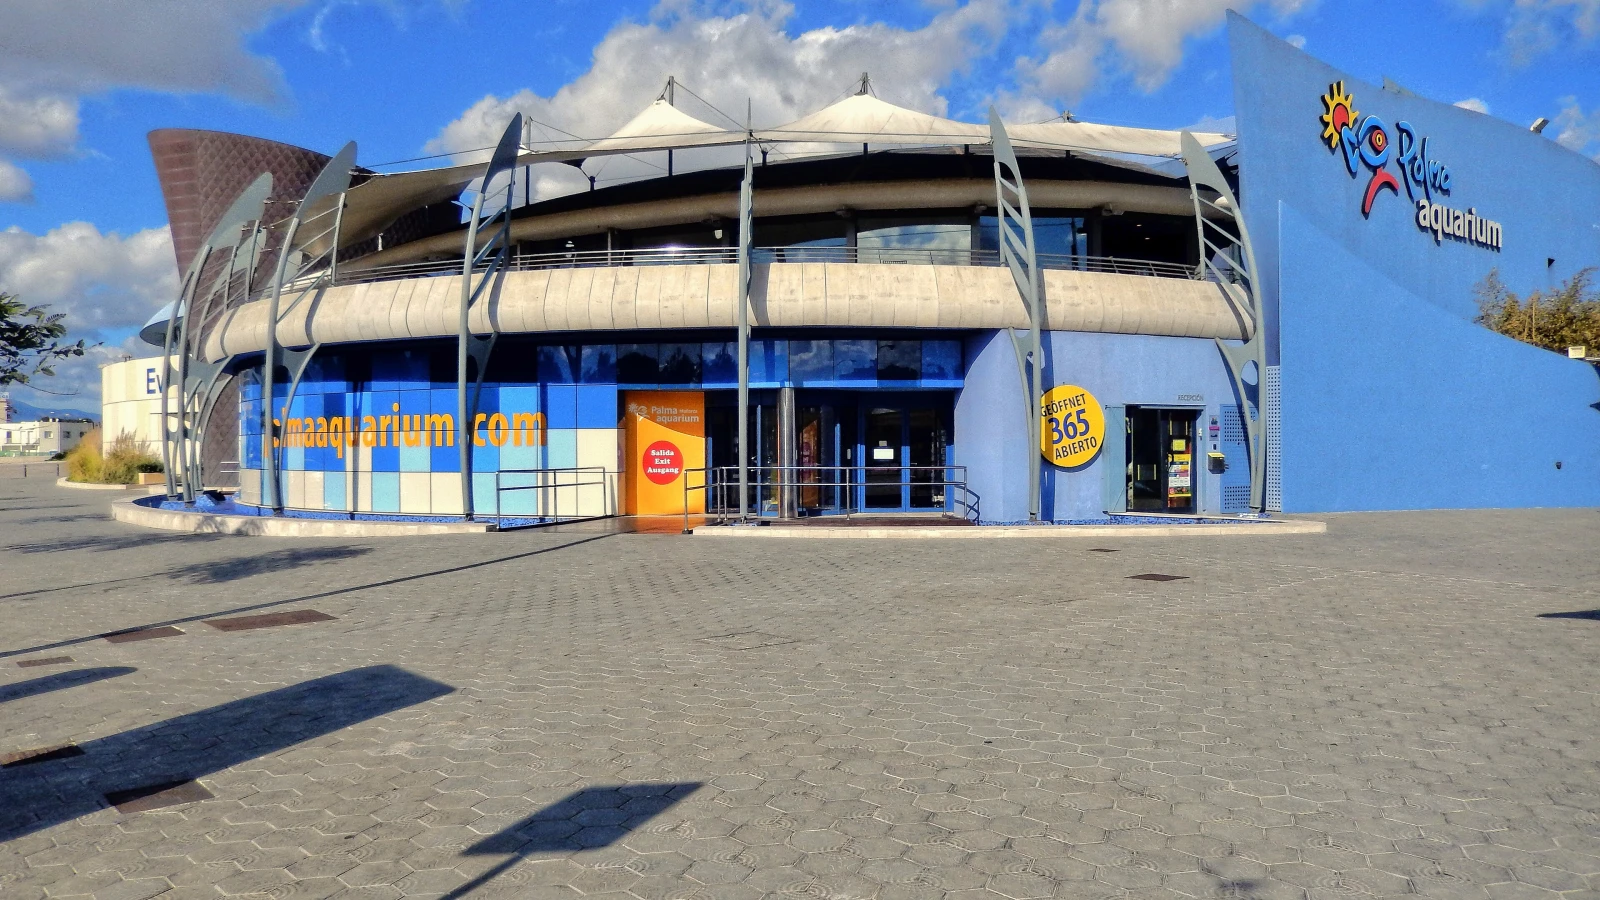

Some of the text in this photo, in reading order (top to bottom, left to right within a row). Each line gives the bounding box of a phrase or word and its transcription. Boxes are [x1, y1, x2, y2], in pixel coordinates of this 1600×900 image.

[1397, 120, 1451, 200] Palma
[1418, 199, 1502, 248] aquarium
[1041, 394, 1086, 417] GEÖFFNET
[1177, 394, 1204, 402] RECEPCIÓN
[651, 405, 678, 415] Palma
[656, 414, 700, 424] aquarium
[264, 402, 547, 459] maaquariumcom
[1048, 409, 1090, 445] 365
[1055, 436, 1097, 460] ABIERTO
[647, 467, 679, 475] Ausgang
